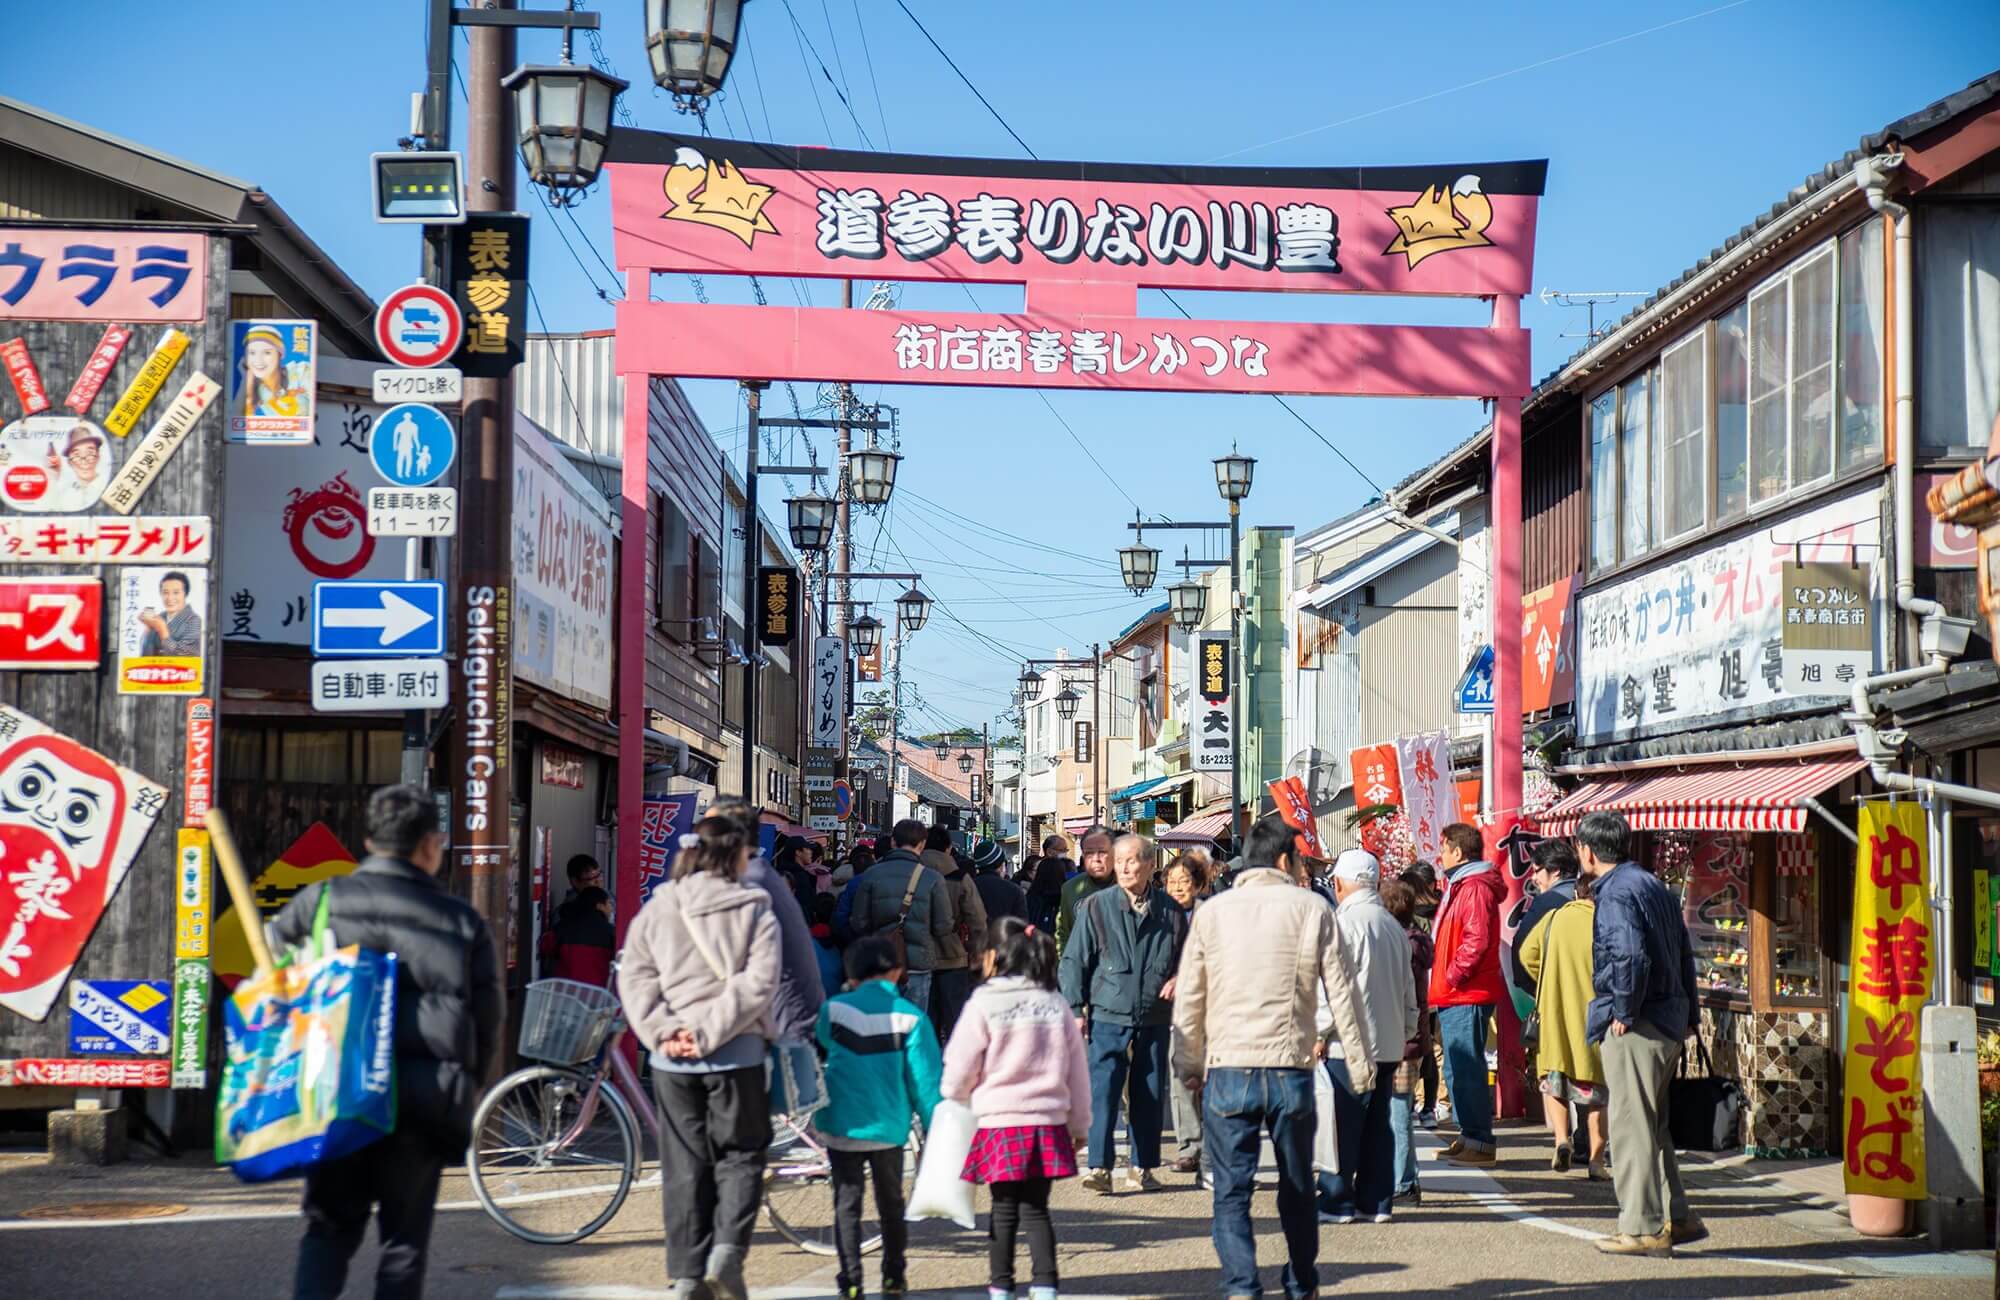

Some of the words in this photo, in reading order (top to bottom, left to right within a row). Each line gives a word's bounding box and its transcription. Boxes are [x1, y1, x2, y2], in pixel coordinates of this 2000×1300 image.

[815, 186, 1342, 274] 豊川いなり表参道
[0, 243, 193, 308] ウララ
[466, 228, 511, 353] 表参道
[894, 322, 1270, 378] なつかし青春商店街
[379, 376, 457, 394] マイクロを除く
[110, 403, 194, 506] 三菱の食用油
[373, 493, 453, 511] 軽車両を除く
[767, 573, 788, 635] 表参道
[1786, 608, 1866, 625] 青春商店街
[1793, 588, 1859, 605] なつかし
[321, 672, 440, 700] 自動車・原付
[463, 585, 495, 747] Sekiguchi
[1205, 643, 1224, 692] 表参道
[1621, 664, 1677, 720] 食堂
[1801, 663, 1856, 683] 旭亭
[465, 754, 495, 832] Cars
[77, 990, 160, 1052] サンビシ醤油
[1846, 823, 1930, 1184] 中華そば
